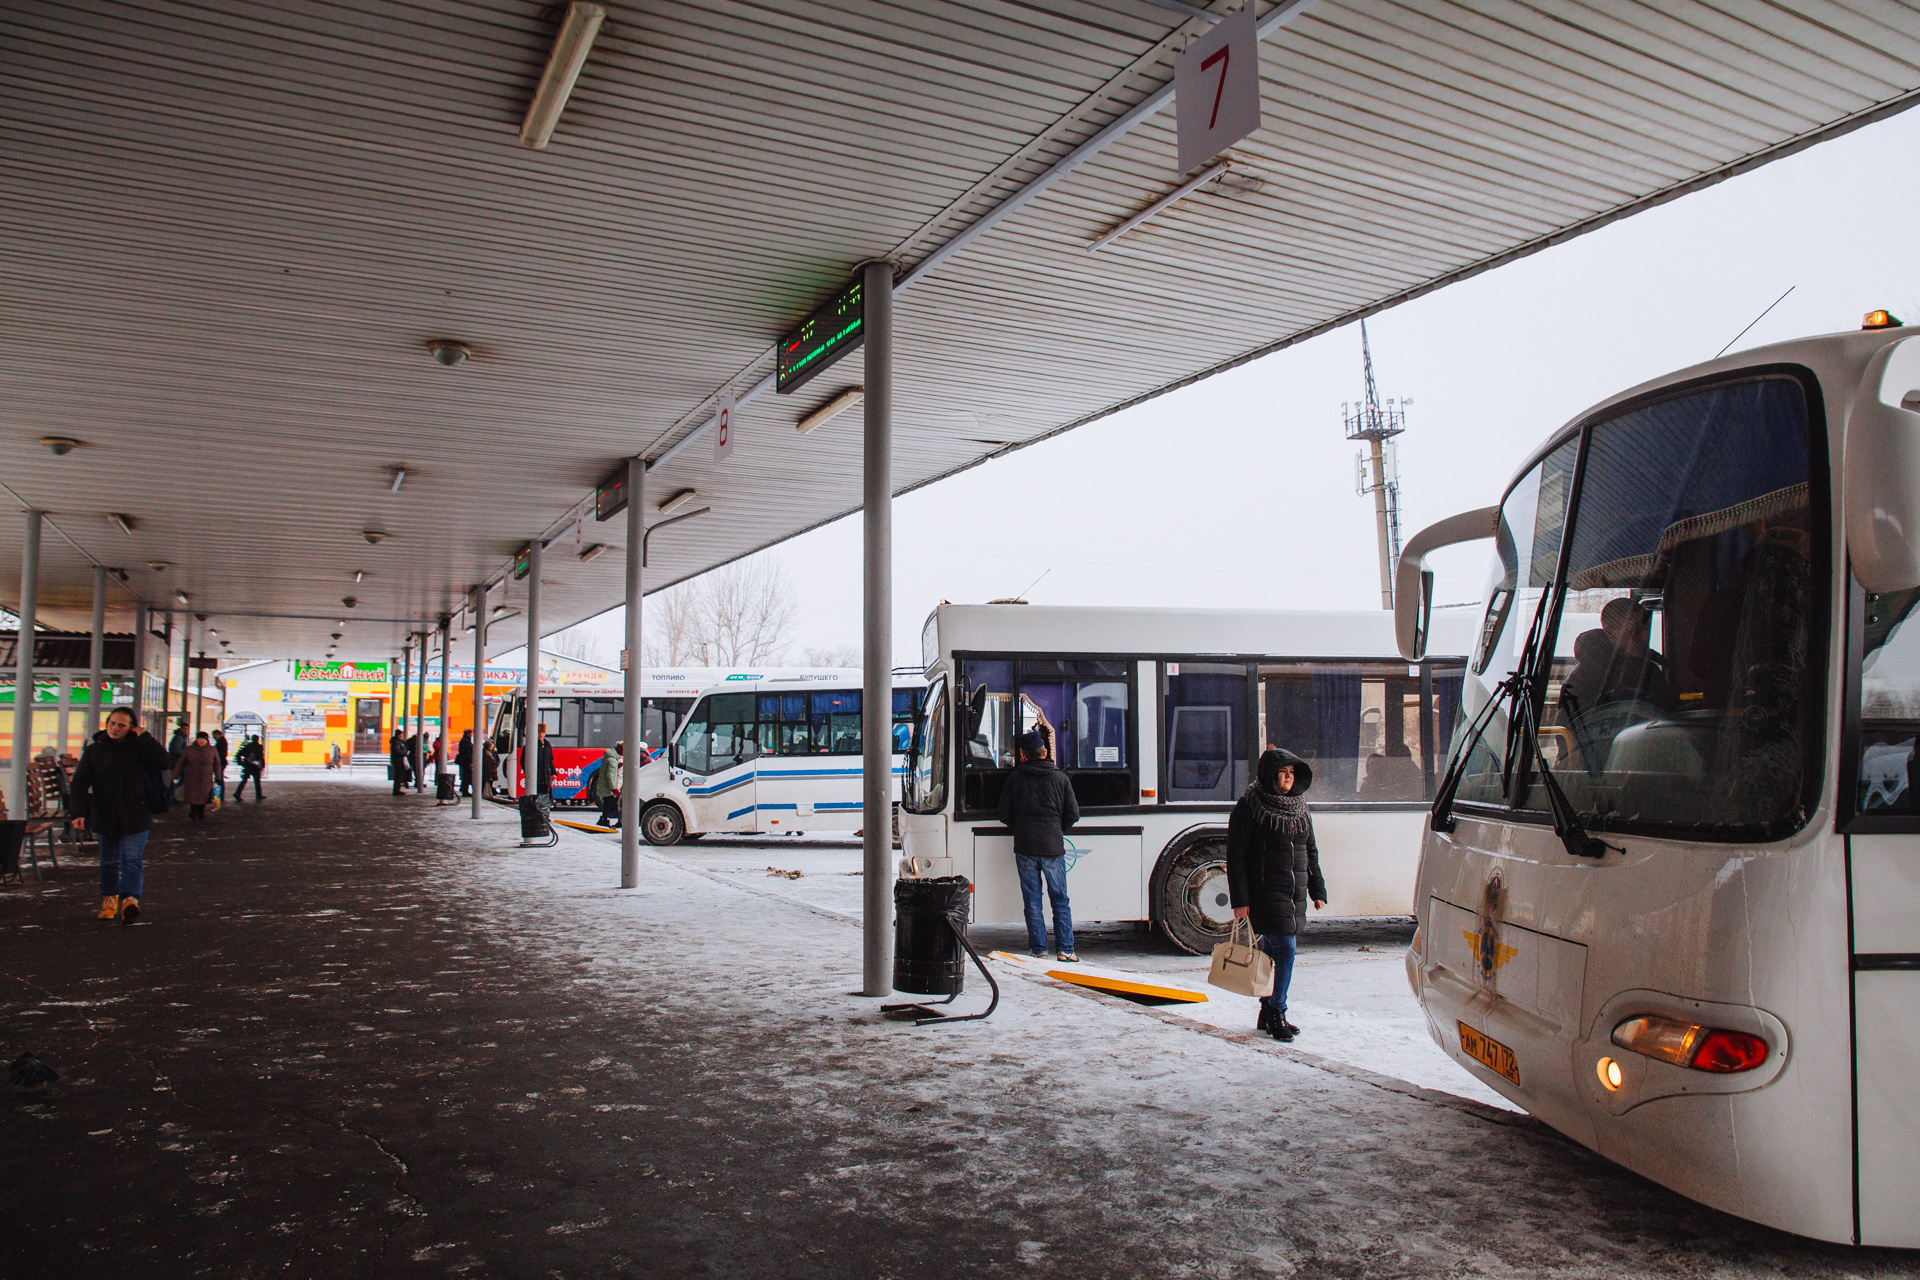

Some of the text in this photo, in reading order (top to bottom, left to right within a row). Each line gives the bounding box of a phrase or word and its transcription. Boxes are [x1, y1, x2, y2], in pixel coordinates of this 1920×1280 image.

[1201, 43, 1230, 130] 7
[719, 408, 728, 446] 8
[296, 663, 386, 682] ДОМАШНИЙ
[565, 672, 604, 680] АРЕНДА
[1480, 1037, 1498, 1067] 747
[1503, 1049, 1515, 1072] 72
